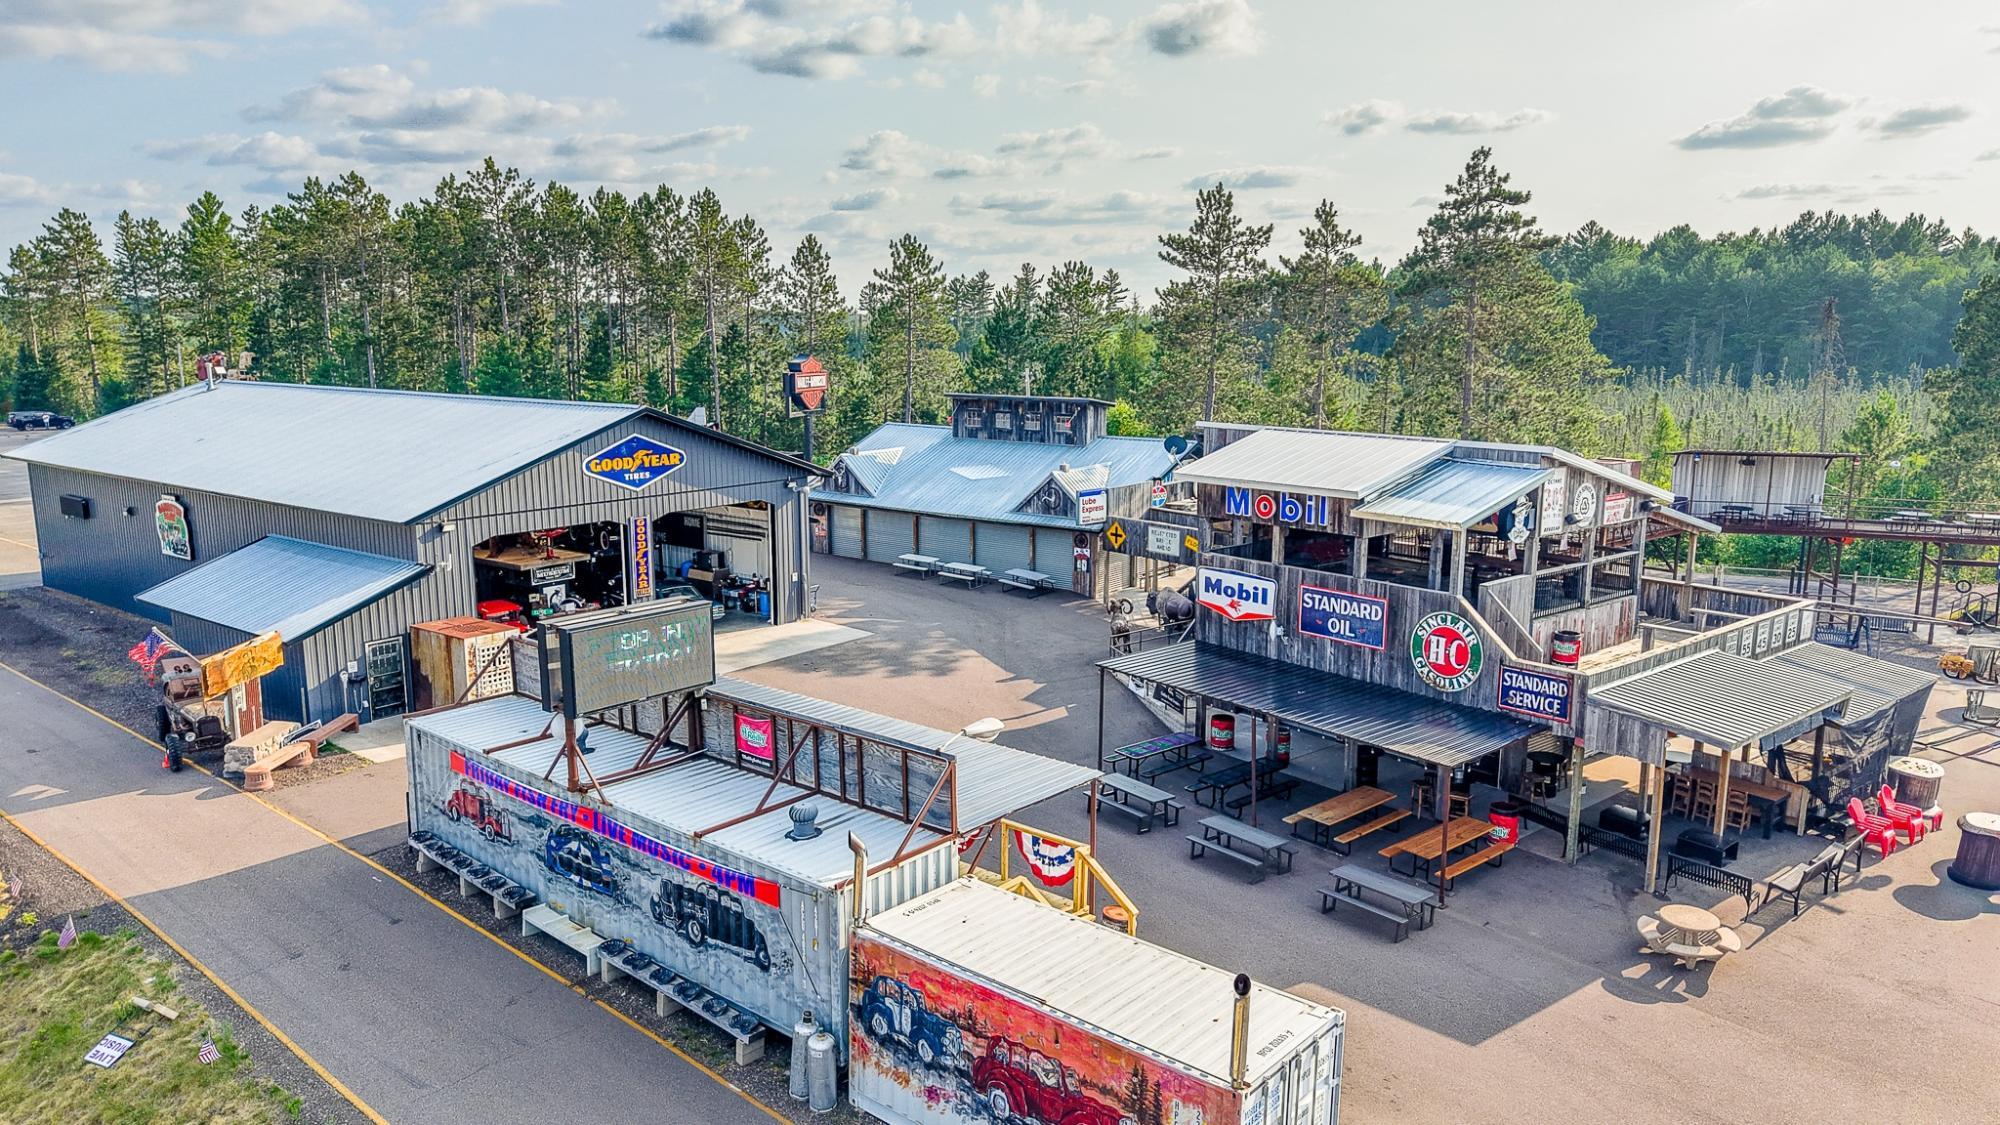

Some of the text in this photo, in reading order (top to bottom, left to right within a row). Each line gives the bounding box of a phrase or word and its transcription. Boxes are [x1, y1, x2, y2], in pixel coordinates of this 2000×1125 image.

[590, 450, 681, 472] GOODYEAR
[624, 471, 650, 480] TIRES
[1082, 505, 1104, 514] Express
[1226, 486, 1328, 526] Mobil
[635, 519, 650, 589] GOODYEAR
[1204, 575, 1269, 606] Mobil
[1303, 592, 1382, 621] STANDARD
[1327, 617, 1355, 637] OIL
[1416, 614, 1478, 647] SINCLAIR
[1787, 626, 1796, 640] 25
[1742, 642, 1751, 656] 55
[1757, 636, 1767, 649] 45
[1772, 632, 1782, 645] 30
[1415, 657, 1477, 690] GASOLINE
[1503, 672, 1568, 698] STANDARD
[1507, 690, 1561, 714] SERVICE
[465, 758, 756, 898] FRIDAY FISH FRY LIVE MUSIC 4PM
[89, 1049, 116, 1064] LIVE
[100, 1038, 128, 1053] MUSIC
